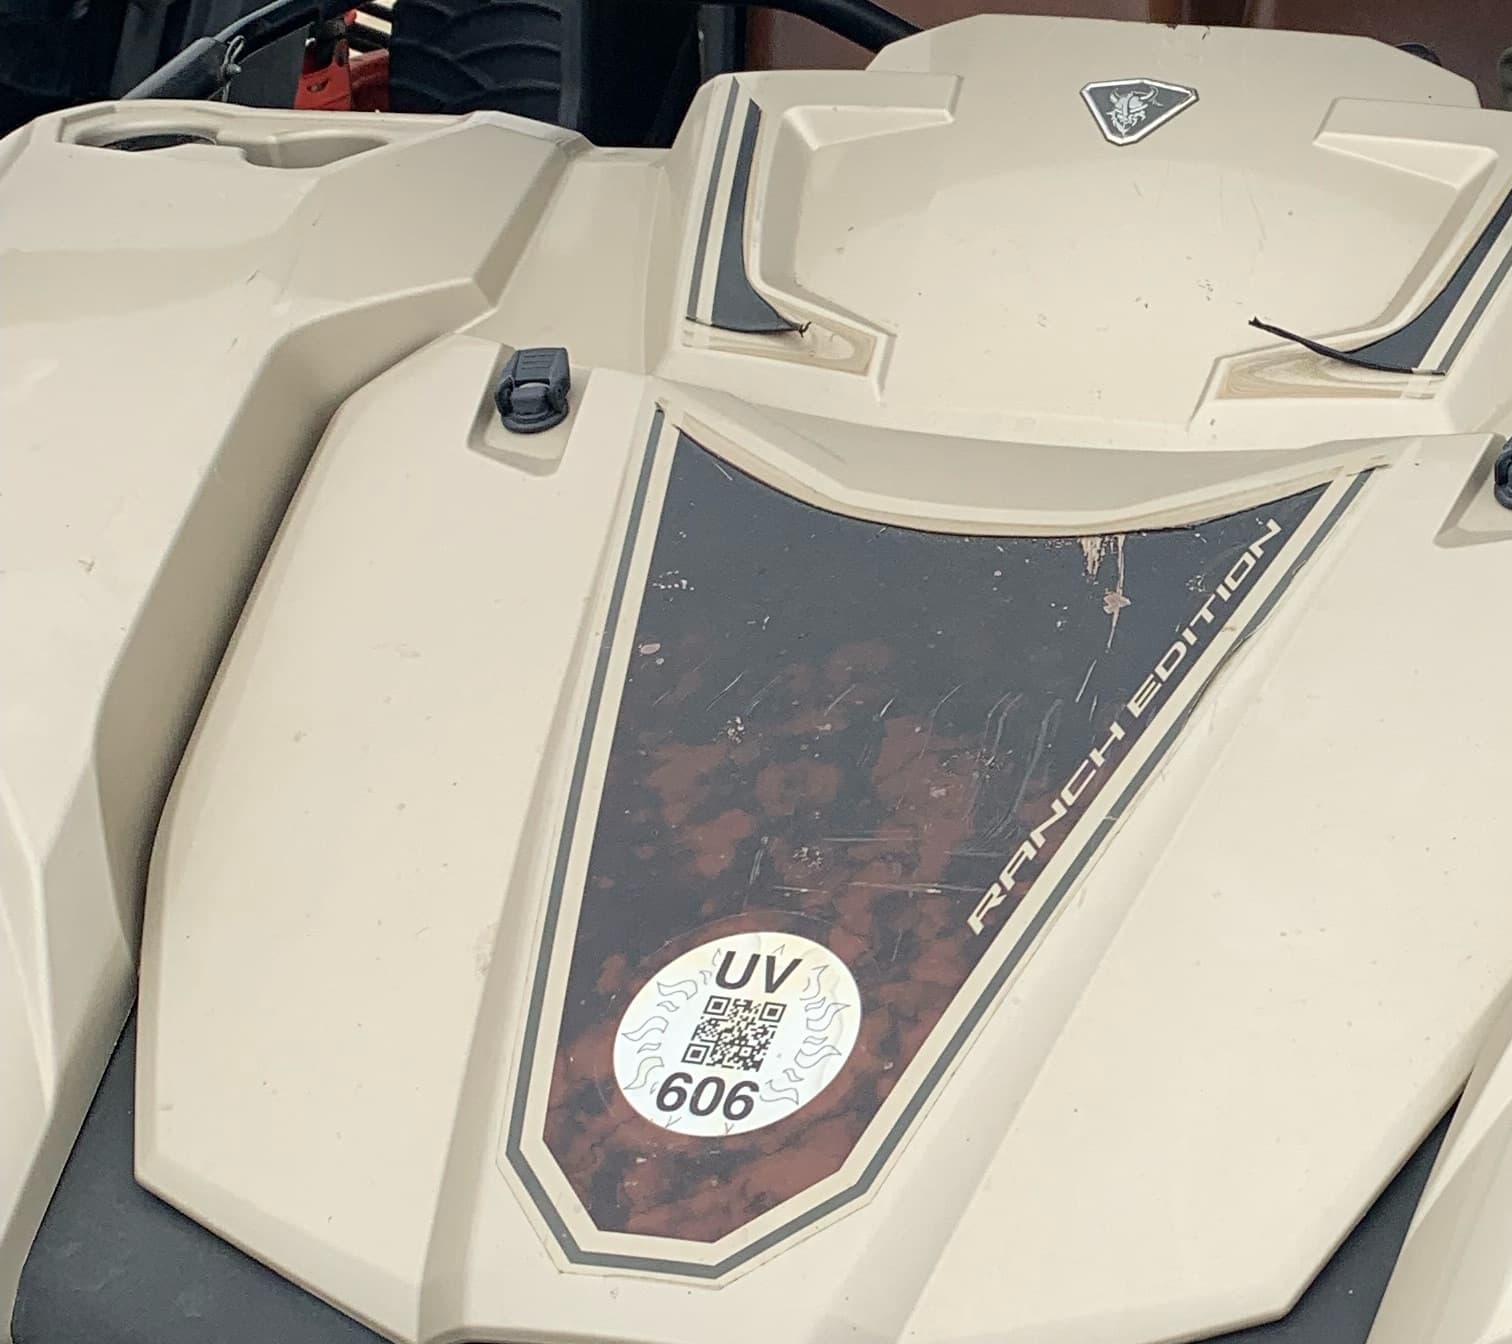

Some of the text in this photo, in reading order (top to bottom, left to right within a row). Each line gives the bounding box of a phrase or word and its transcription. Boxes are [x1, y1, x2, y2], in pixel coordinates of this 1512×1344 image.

[967, 518, 1282, 936] RANCH EDITION
[715, 950, 803, 994] UV
[655, 1071, 760, 1122] 606
